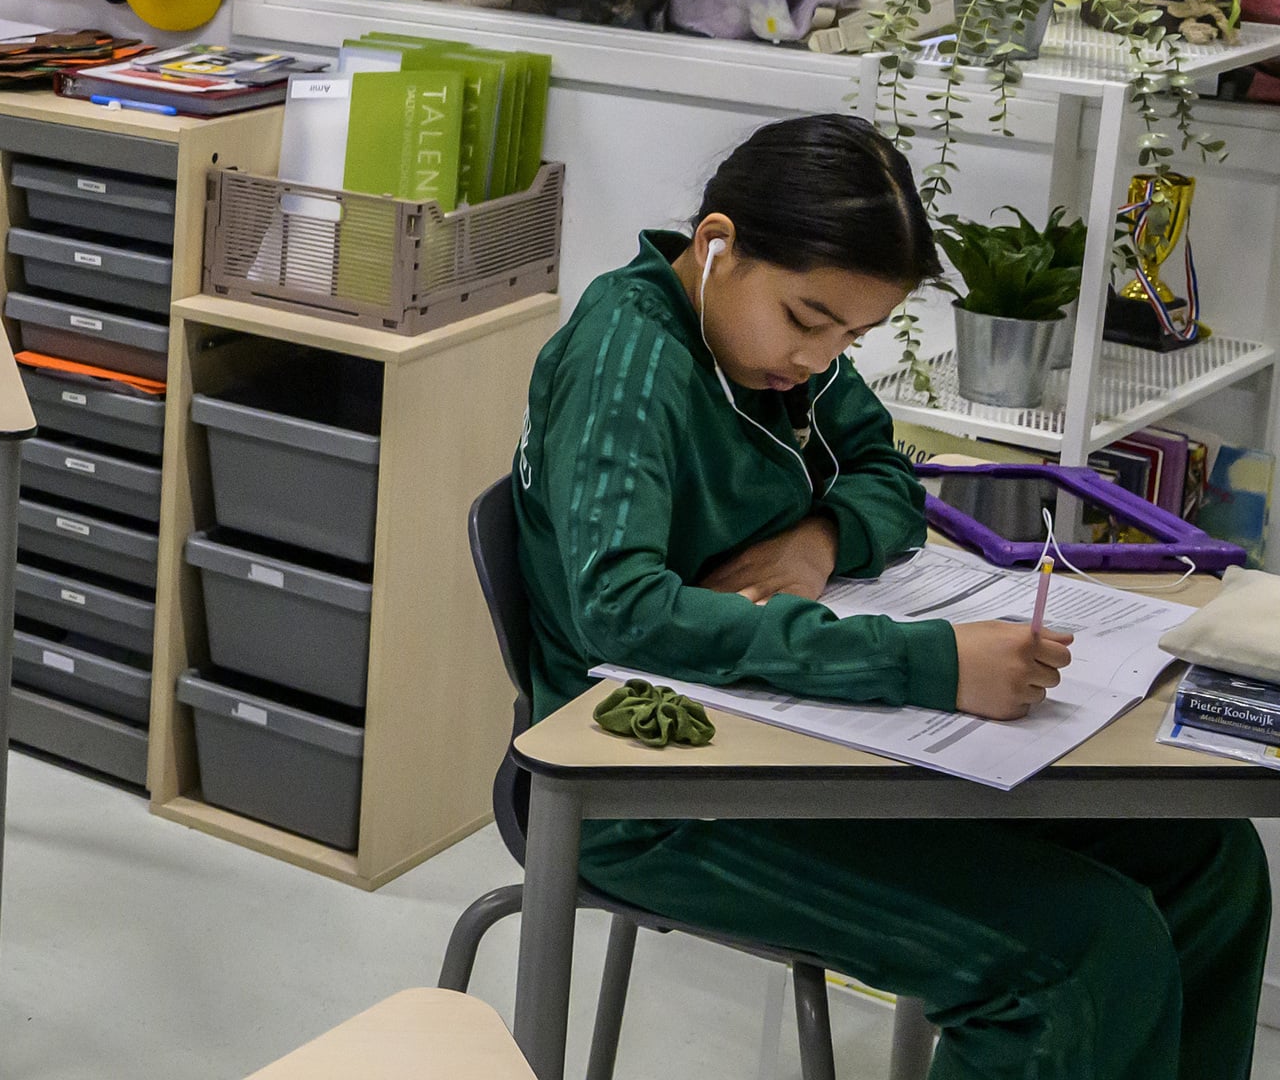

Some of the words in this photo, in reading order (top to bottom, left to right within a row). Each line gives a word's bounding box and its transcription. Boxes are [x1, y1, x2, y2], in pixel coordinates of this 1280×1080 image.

[309, 83, 331, 93] Amir
[1190, 699, 1222, 713] Pieter
[1224, 707, 1274, 726] Koolwijk
